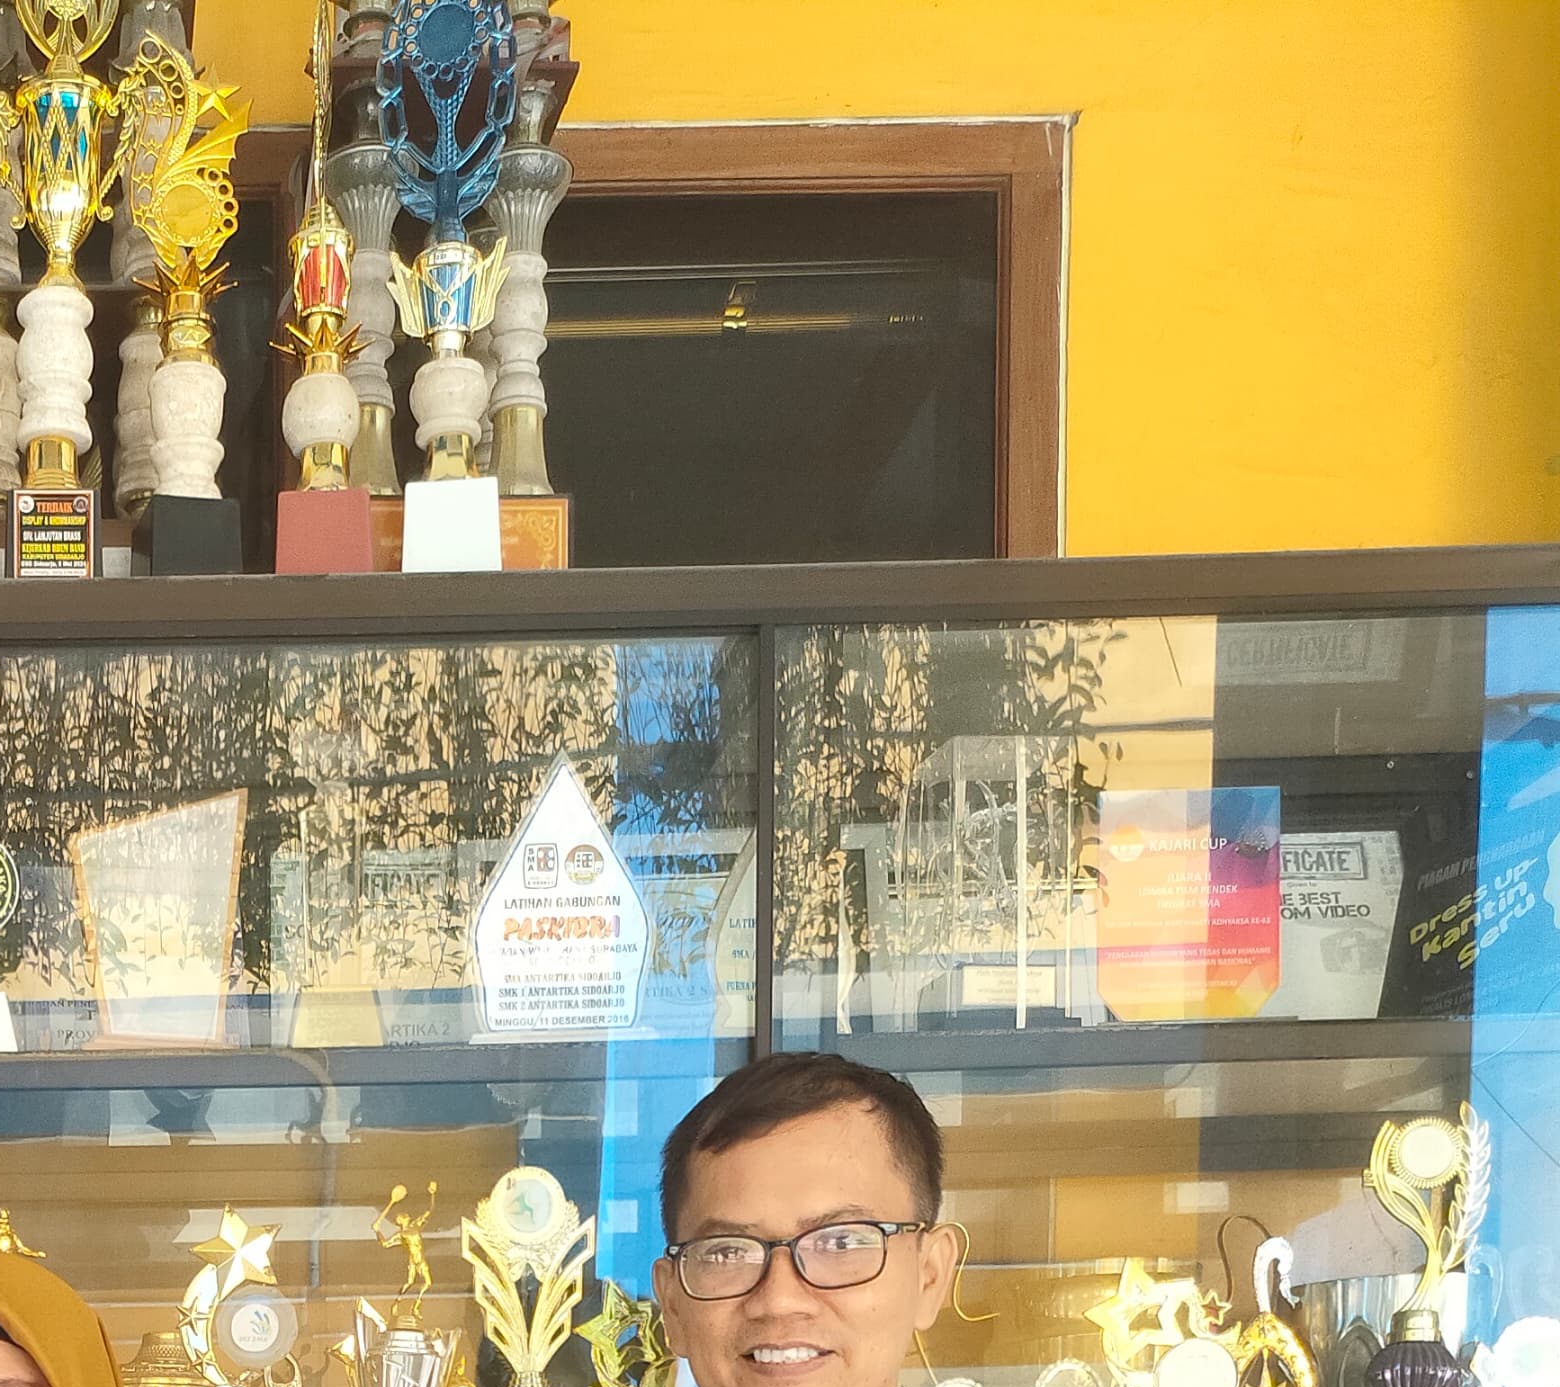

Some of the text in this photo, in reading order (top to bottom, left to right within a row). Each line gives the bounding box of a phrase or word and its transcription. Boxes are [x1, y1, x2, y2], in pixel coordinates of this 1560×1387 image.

[36, 502, 73, 513] TERBAIK
[1148, 837, 1229, 852] KAJARI CUP
[527, 848, 536, 872] SMA
[1168, 872, 1202, 883] JUARA
[1417, 860, 1460, 891] PIAGAM
[1200, 884, 1238, 895] PENDEK
[504, 895, 621, 910] LATIHAN GABUNGAN
[1201, 898, 1221, 908] SMA
[1317, 904, 1371, 919] VIDEO
[1409, 884, 1488, 945] Dress
[503, 914, 621, 942] PASKIBRA
[1422, 881, 1528, 962] Kantin
[1457, 892, 1536, 971] Seru
[525, 973, 575, 984] ANTARTIKA
[498, 988, 520, 998] SMK
[528, 986, 579, 997] ANTARTIKA
[582, 985, 625, 996] SIDOARJO
[498, 1000, 519, 1011] SMK
[528, 999, 579, 1011] ANTARTIKA
[582, 998, 625, 1010] SIDOARJO
[552, 1016, 606, 1026] DESEMBER
